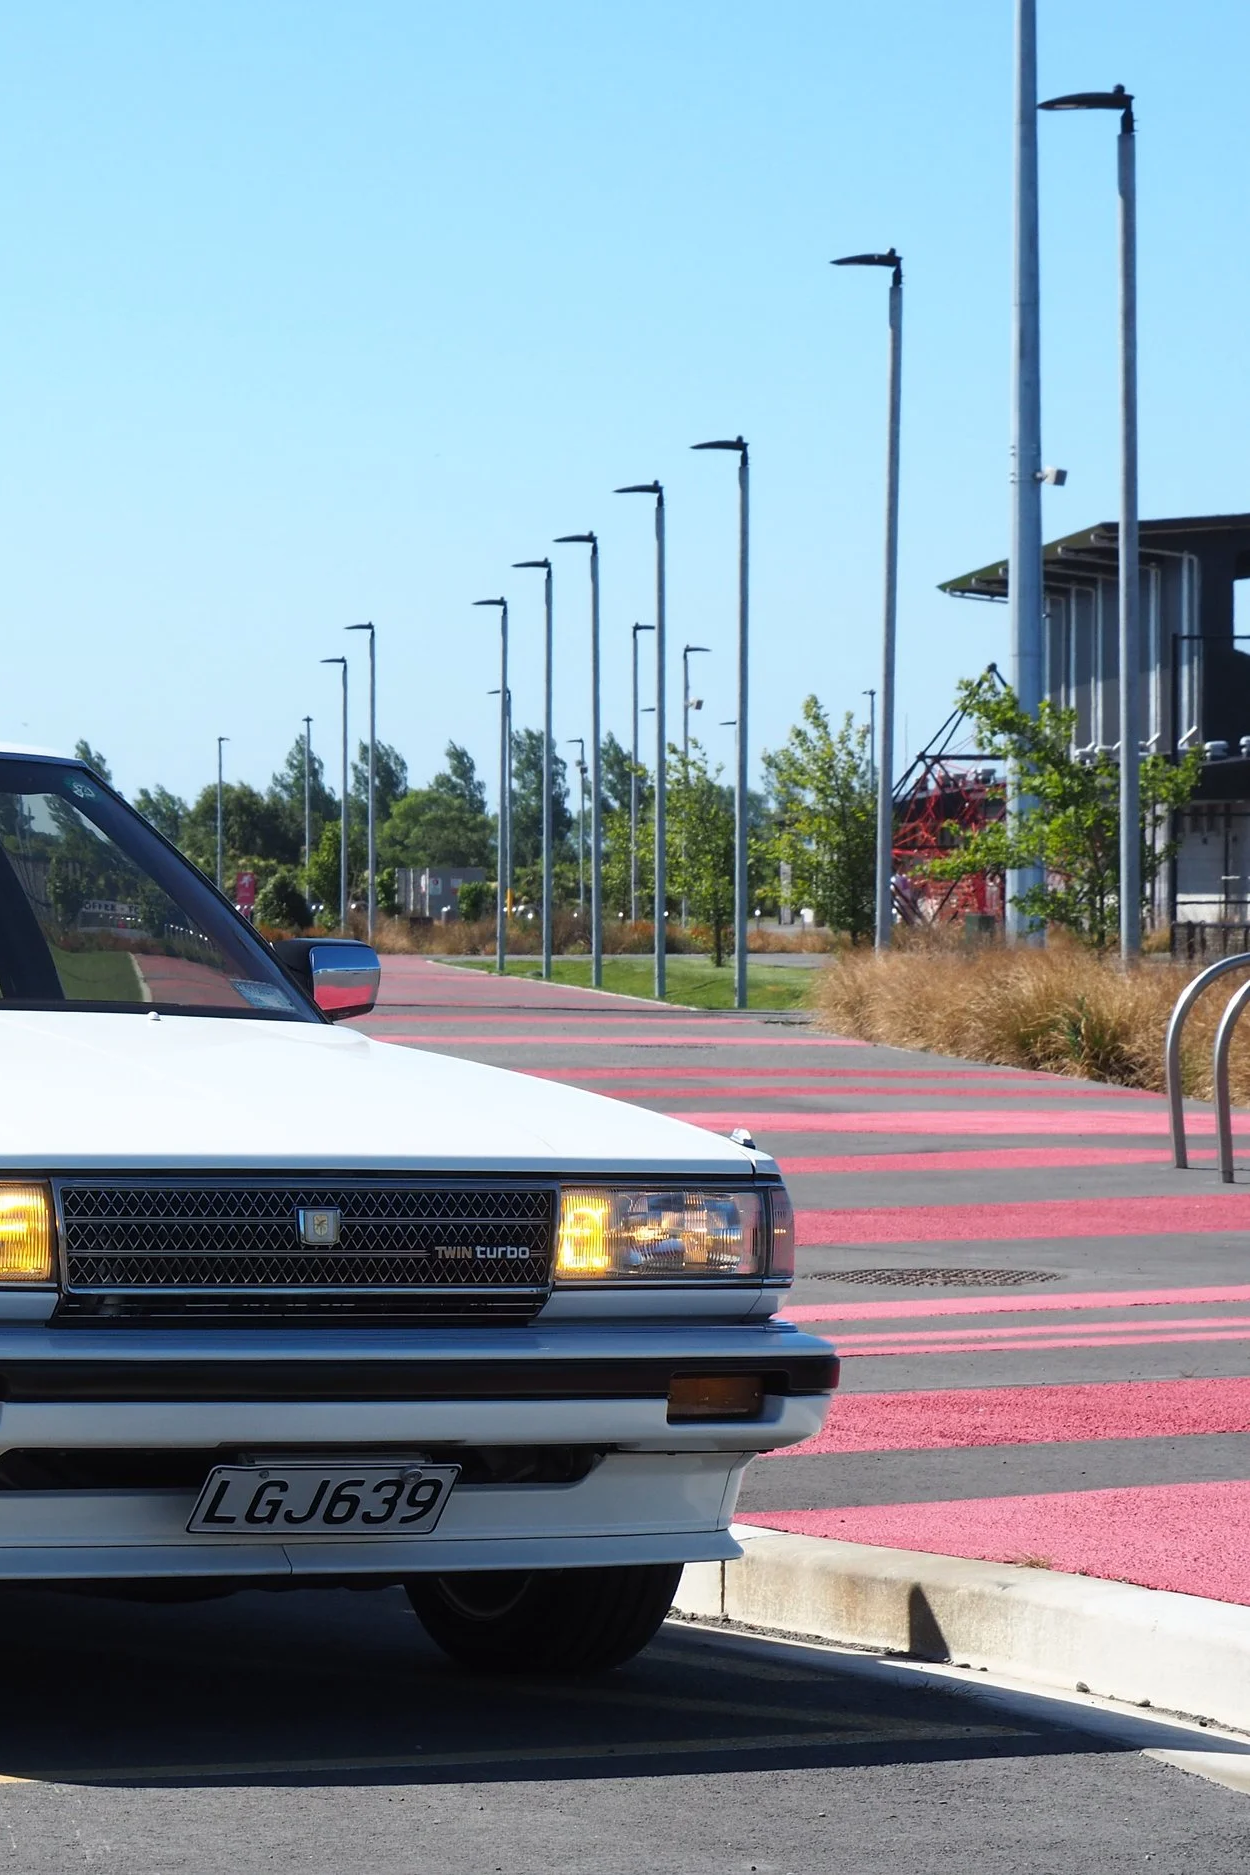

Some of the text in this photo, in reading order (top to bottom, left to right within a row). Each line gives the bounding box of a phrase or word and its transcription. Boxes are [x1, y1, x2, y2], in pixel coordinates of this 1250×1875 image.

[434, 1245, 530, 1259] TWIN turbo
[202, 1479, 443, 1524] LGJ639
